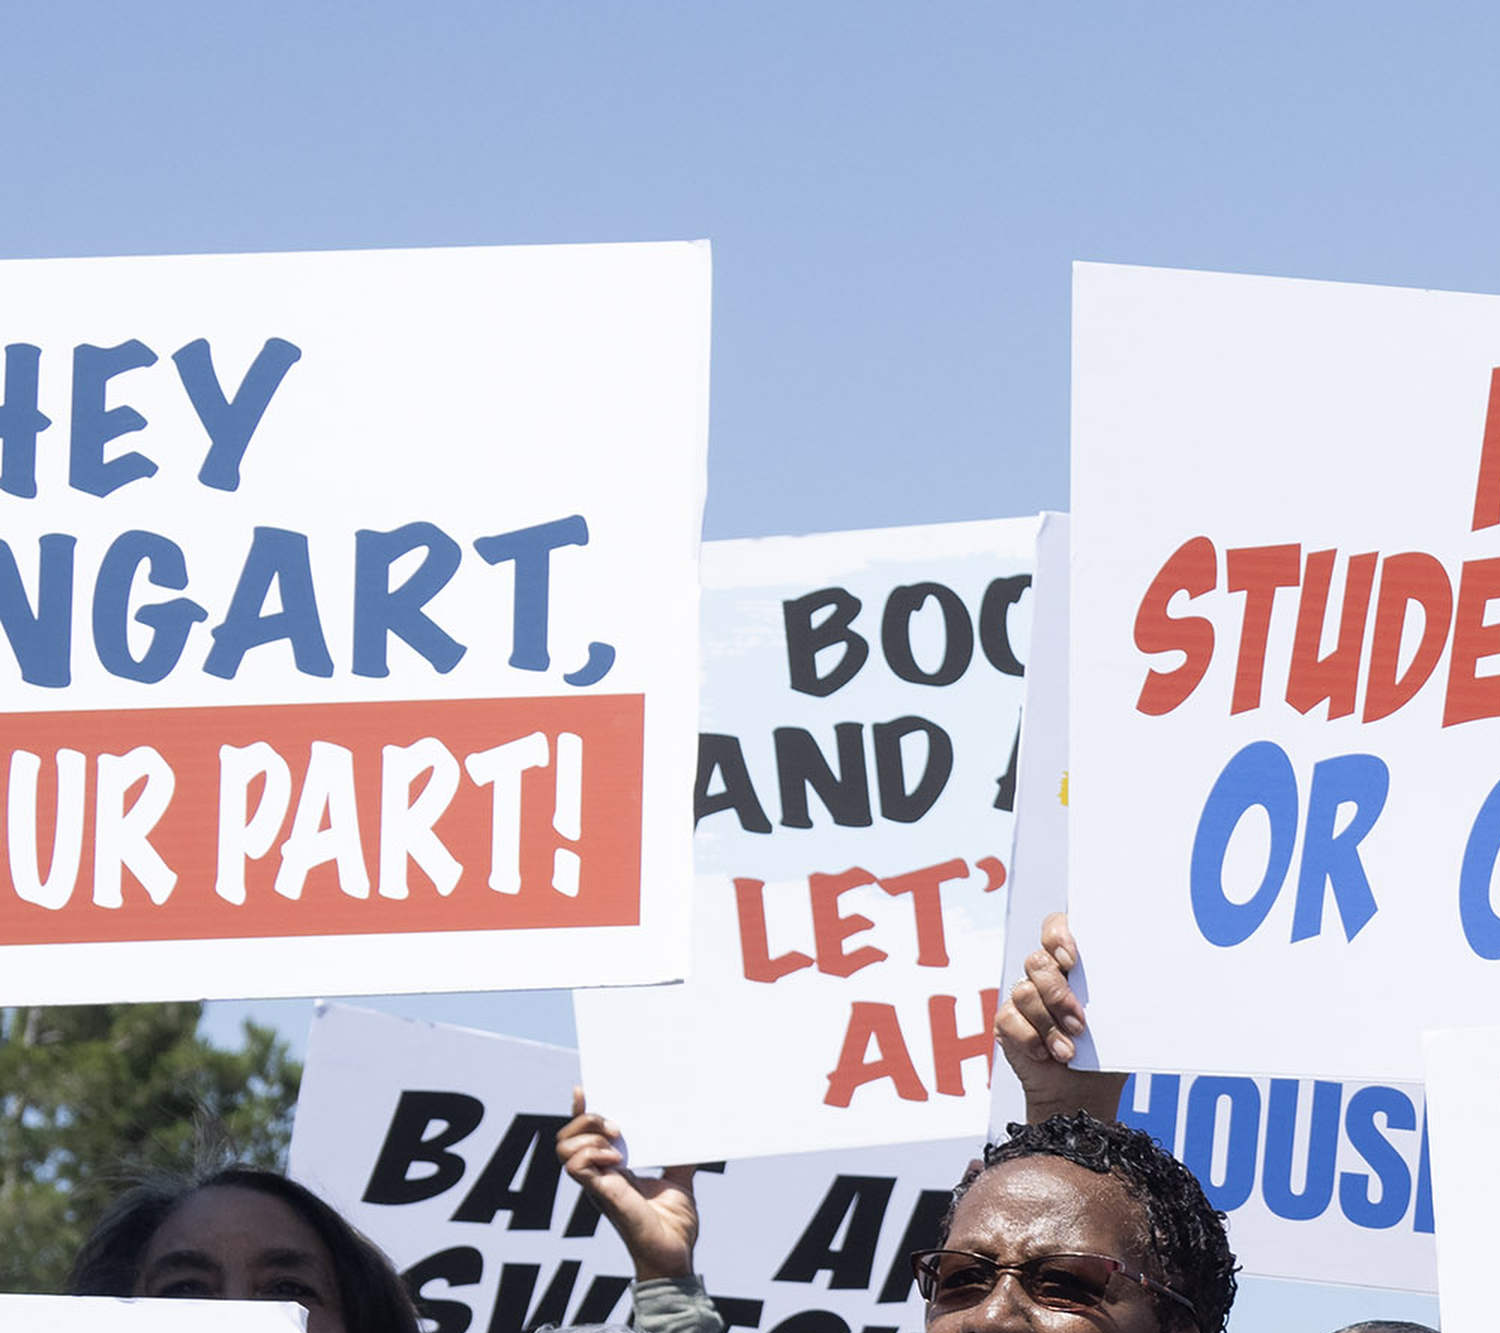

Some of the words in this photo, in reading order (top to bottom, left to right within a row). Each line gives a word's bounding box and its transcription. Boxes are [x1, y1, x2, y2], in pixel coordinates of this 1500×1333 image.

[216, 732, 582, 905] PART!
[694, 716, 953, 834] AND
[1190, 741, 1390, 947] OR
[361, 1090, 725, 1238] BA
[1117, 1072, 1435, 1234] HOUS
